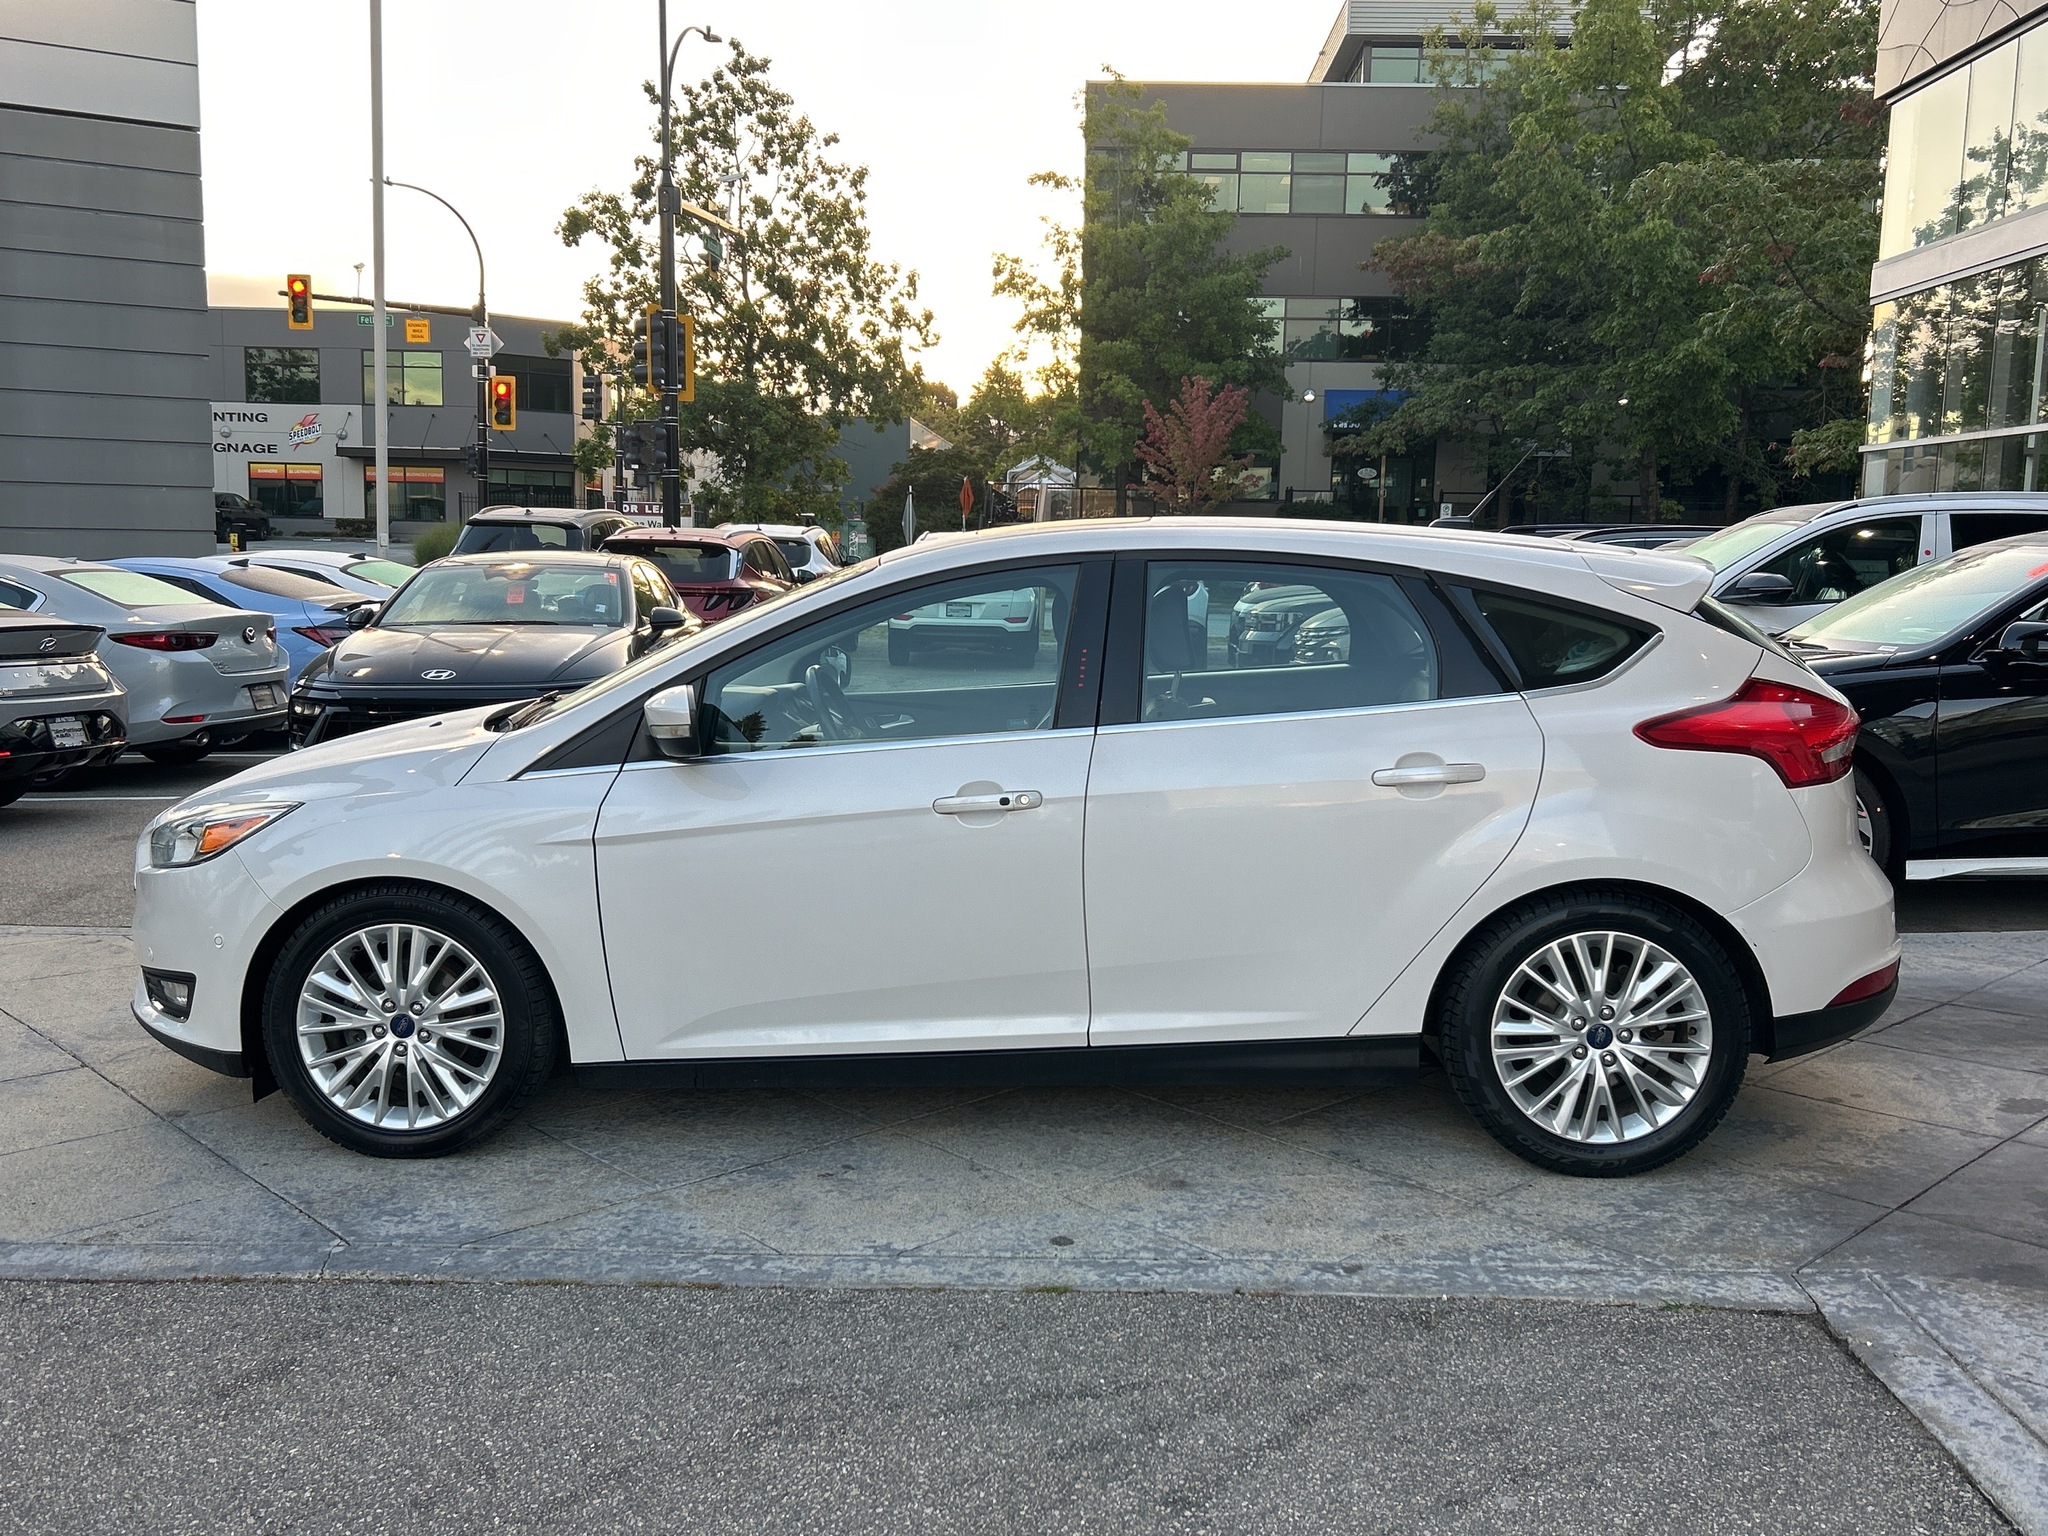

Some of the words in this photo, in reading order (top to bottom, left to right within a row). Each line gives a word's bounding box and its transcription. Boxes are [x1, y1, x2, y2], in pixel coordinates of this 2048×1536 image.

[213, 412, 268, 423] NTING
[288, 423, 322, 441] SPEEDBOLT
[213, 443, 278, 454] GNAGE
[1516, 1134, 1574, 1165] ZERO
[1590, 1157, 1630, 1169] ICE
